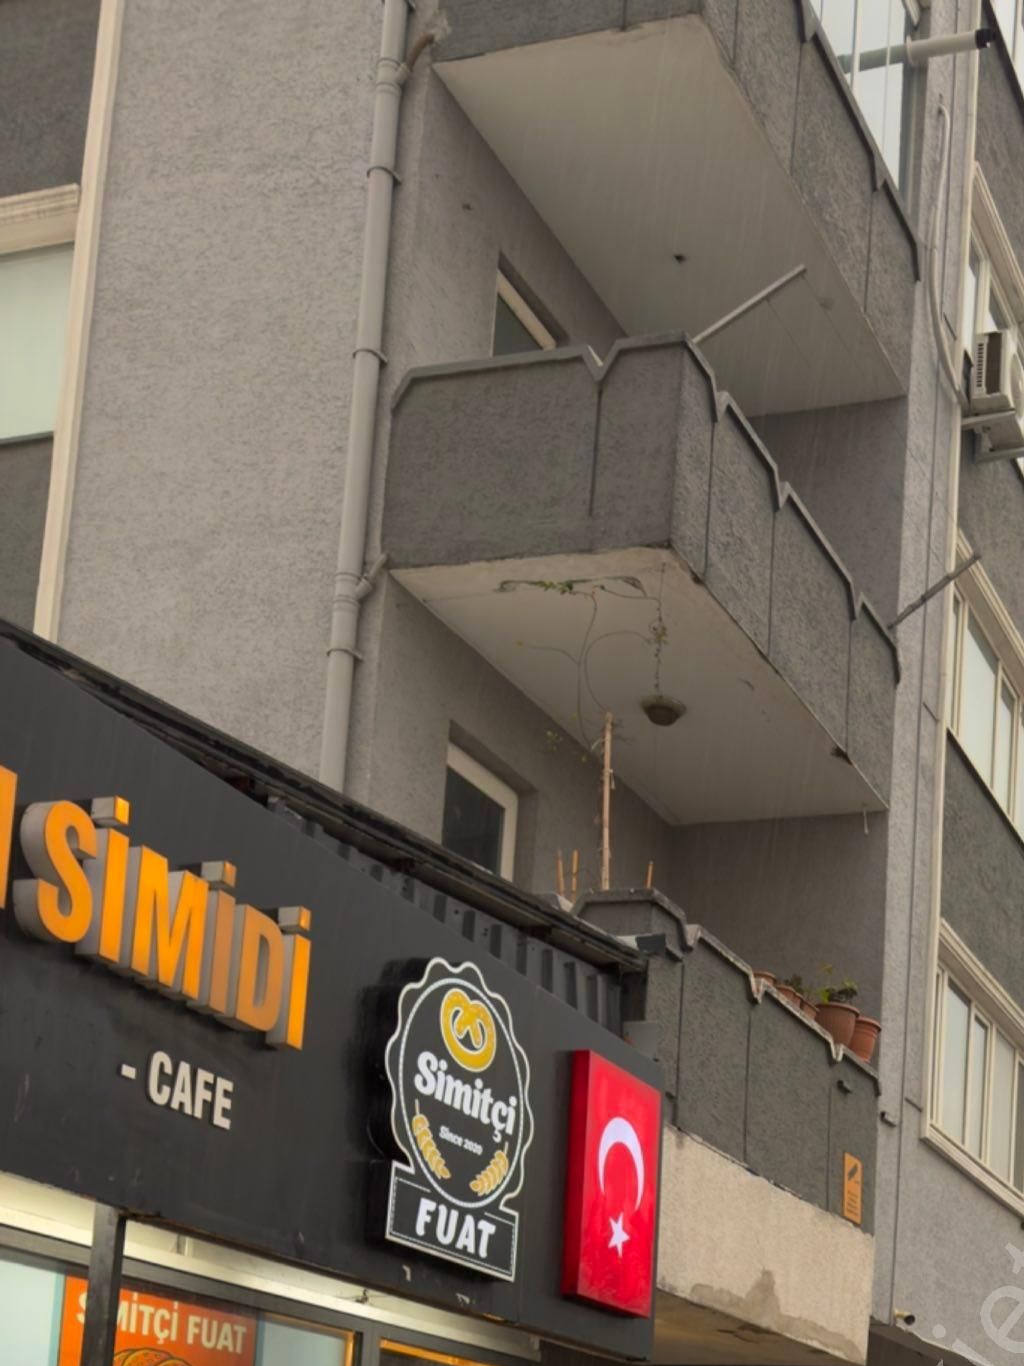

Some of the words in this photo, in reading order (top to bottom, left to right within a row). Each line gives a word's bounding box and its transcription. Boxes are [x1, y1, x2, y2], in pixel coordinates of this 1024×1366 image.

[13, 796, 311, 1050] SİMİDİ
[149, 1051, 234, 1130] CAFE
[414, 1051, 516, 1143] Simitçi
[415, 1197, 496, 1258] FUAT
[76, 1292, 179, 1345] SMİTÇİ
[187, 1314, 247, 1354] FUAT
